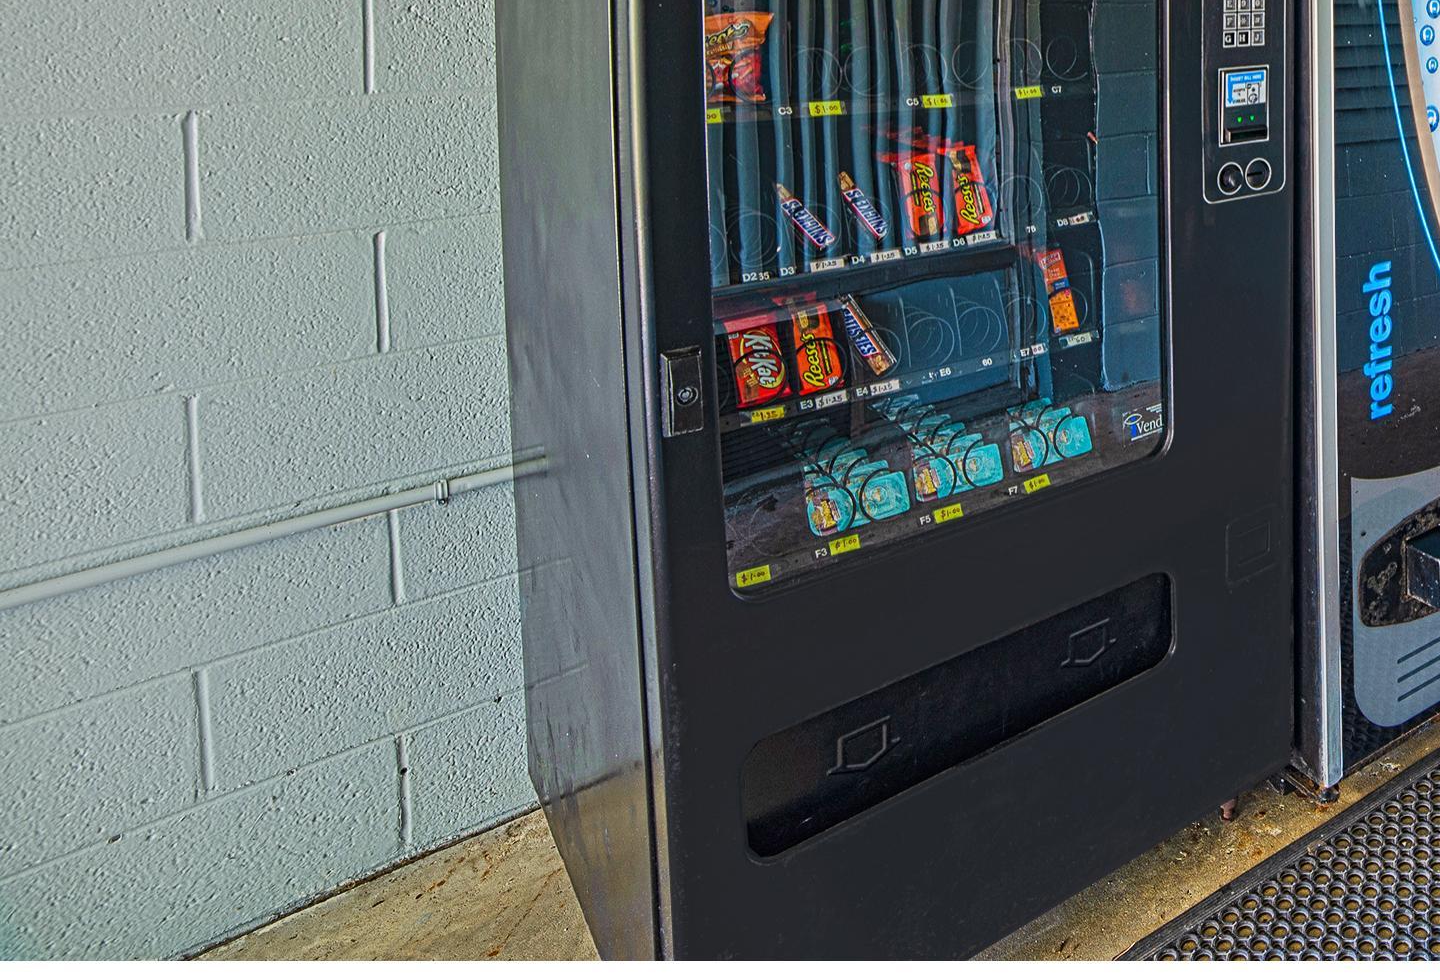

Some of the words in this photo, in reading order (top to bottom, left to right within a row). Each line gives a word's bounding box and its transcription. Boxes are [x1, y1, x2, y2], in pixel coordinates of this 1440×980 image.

[906, 98, 919, 107] C5
[778, 107, 793, 116] C3
[905, 247, 918, 256] D5
[852, 256, 865, 265] D4
[780, 267, 795, 277] D3
[742, 273, 757, 282] D2
[1362, 260, 1394, 421] refresh
[857, 387, 869, 396] E4
[801, 399, 813, 409] E3
[1008, 486, 1018, 495] F7
[920, 516, 932, 525] F5
[815, 548, 828, 559] F3
